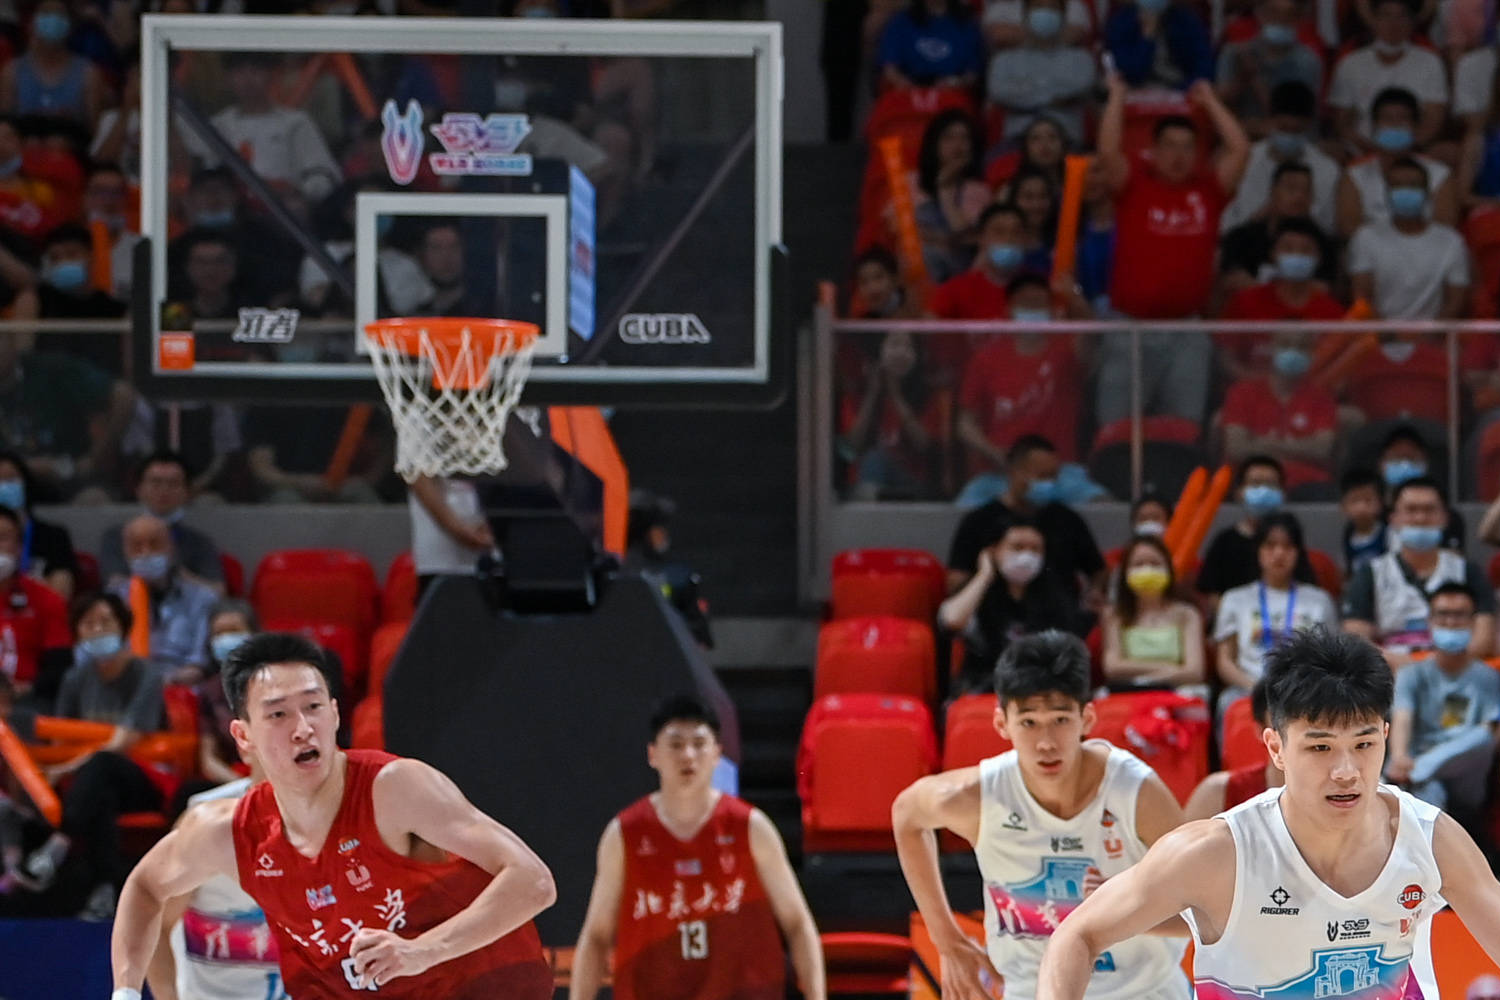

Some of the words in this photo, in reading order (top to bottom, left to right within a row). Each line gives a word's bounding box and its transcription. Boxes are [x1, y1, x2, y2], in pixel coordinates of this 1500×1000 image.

[619, 314, 711, 343] CUBA
[1260, 907, 1300, 916] RIGORER
[678, 920, 708, 960] 13
